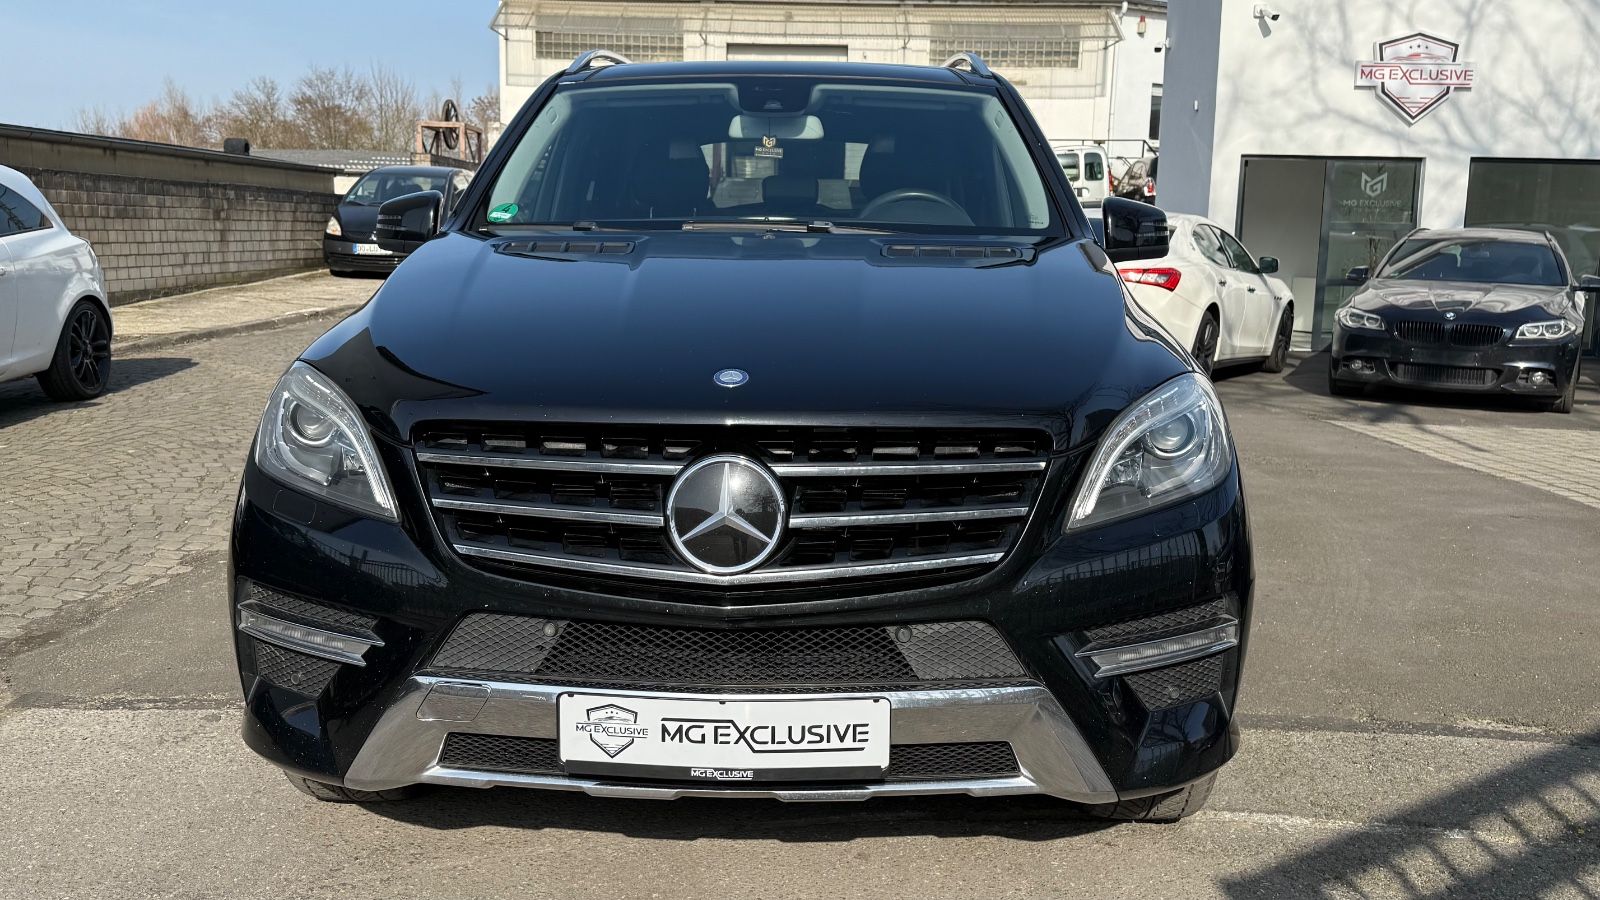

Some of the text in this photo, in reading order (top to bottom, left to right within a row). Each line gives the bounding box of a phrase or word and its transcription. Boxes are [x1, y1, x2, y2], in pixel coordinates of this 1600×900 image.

[1360, 68, 1474, 82] MG EXCLUSIVE
[1359, 200, 1402, 208] EXCLUSIVE
[575, 724, 649, 736] MG EXCLUSIVE
[661, 722, 870, 746] MG EXCLUSIVE
[706, 770, 754, 778] EXCLUSIVE
